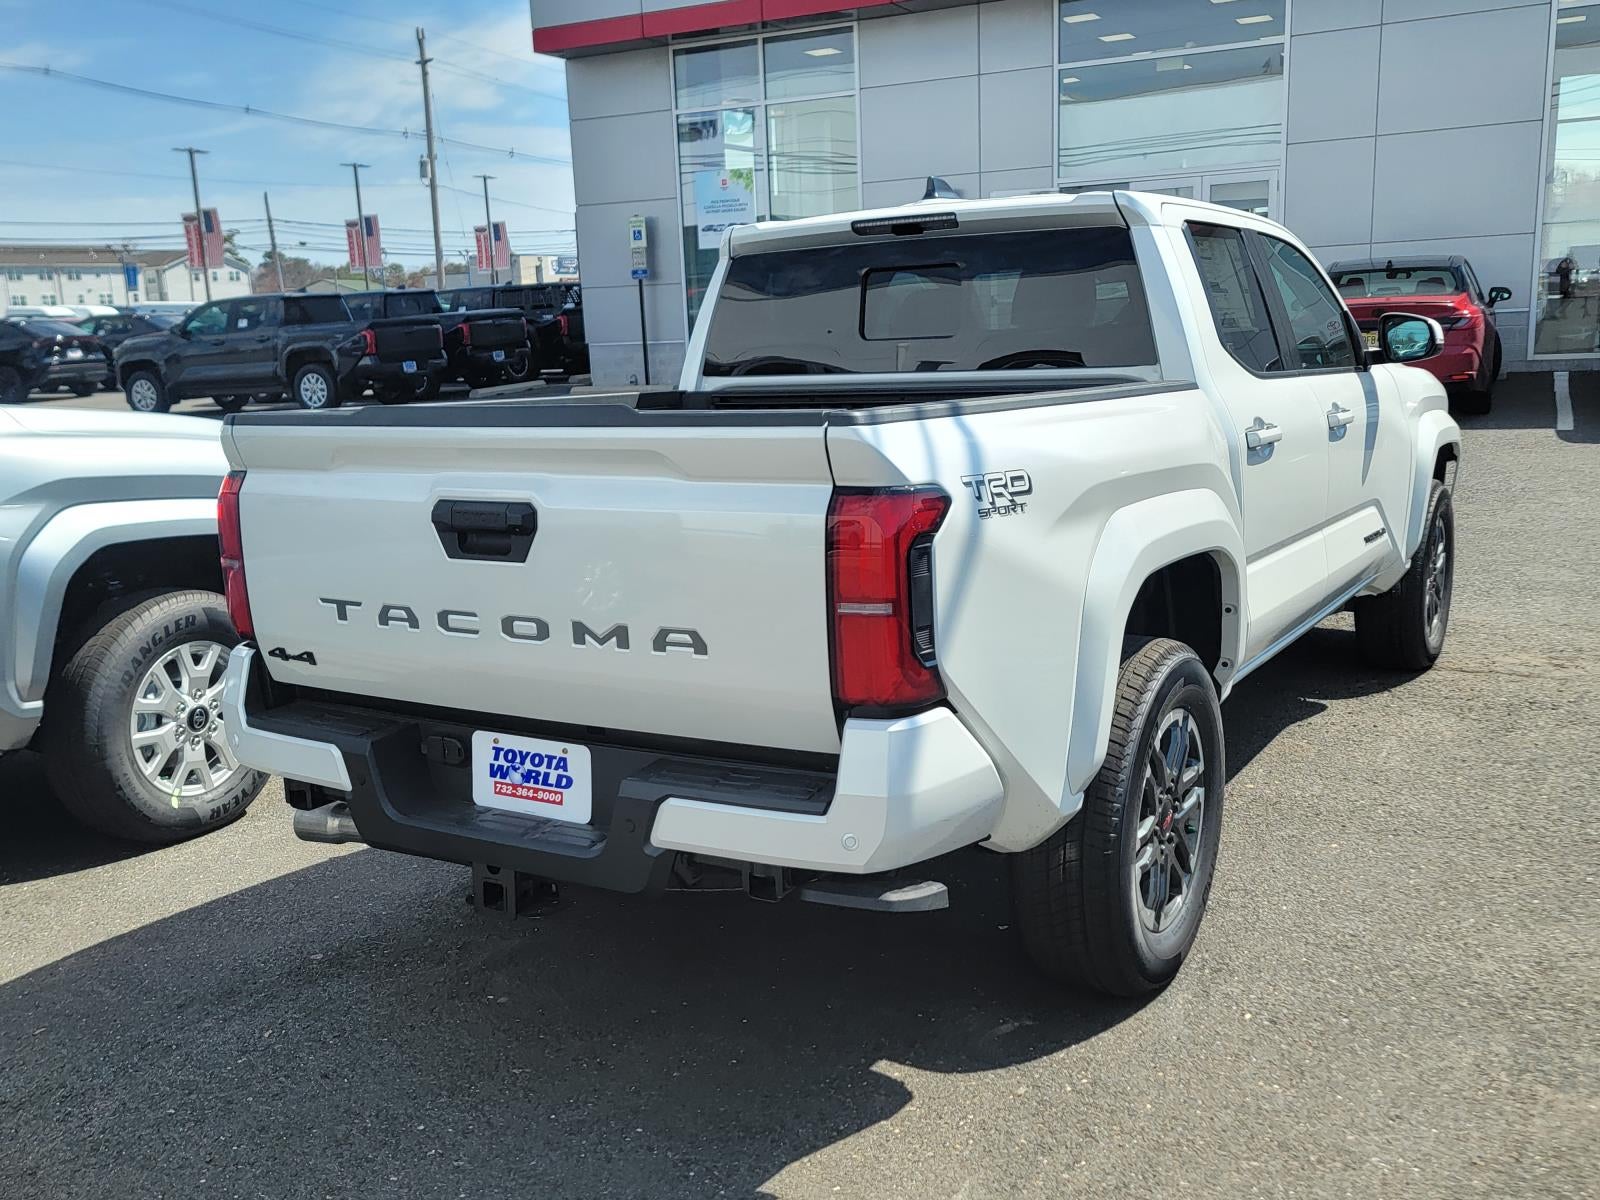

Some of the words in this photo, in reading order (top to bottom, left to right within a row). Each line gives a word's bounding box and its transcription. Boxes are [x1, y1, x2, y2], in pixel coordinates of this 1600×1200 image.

[961, 469, 1033, 504] TRD
[978, 502, 1028, 519] SPORT
[318, 596, 709, 658] TACOMA
[117, 613, 197, 694] RANGLER
[492, 746, 569, 773] TOYOTA
[489, 763, 574, 790] WORLD
[495, 783, 562, 803] 732-364-9000
